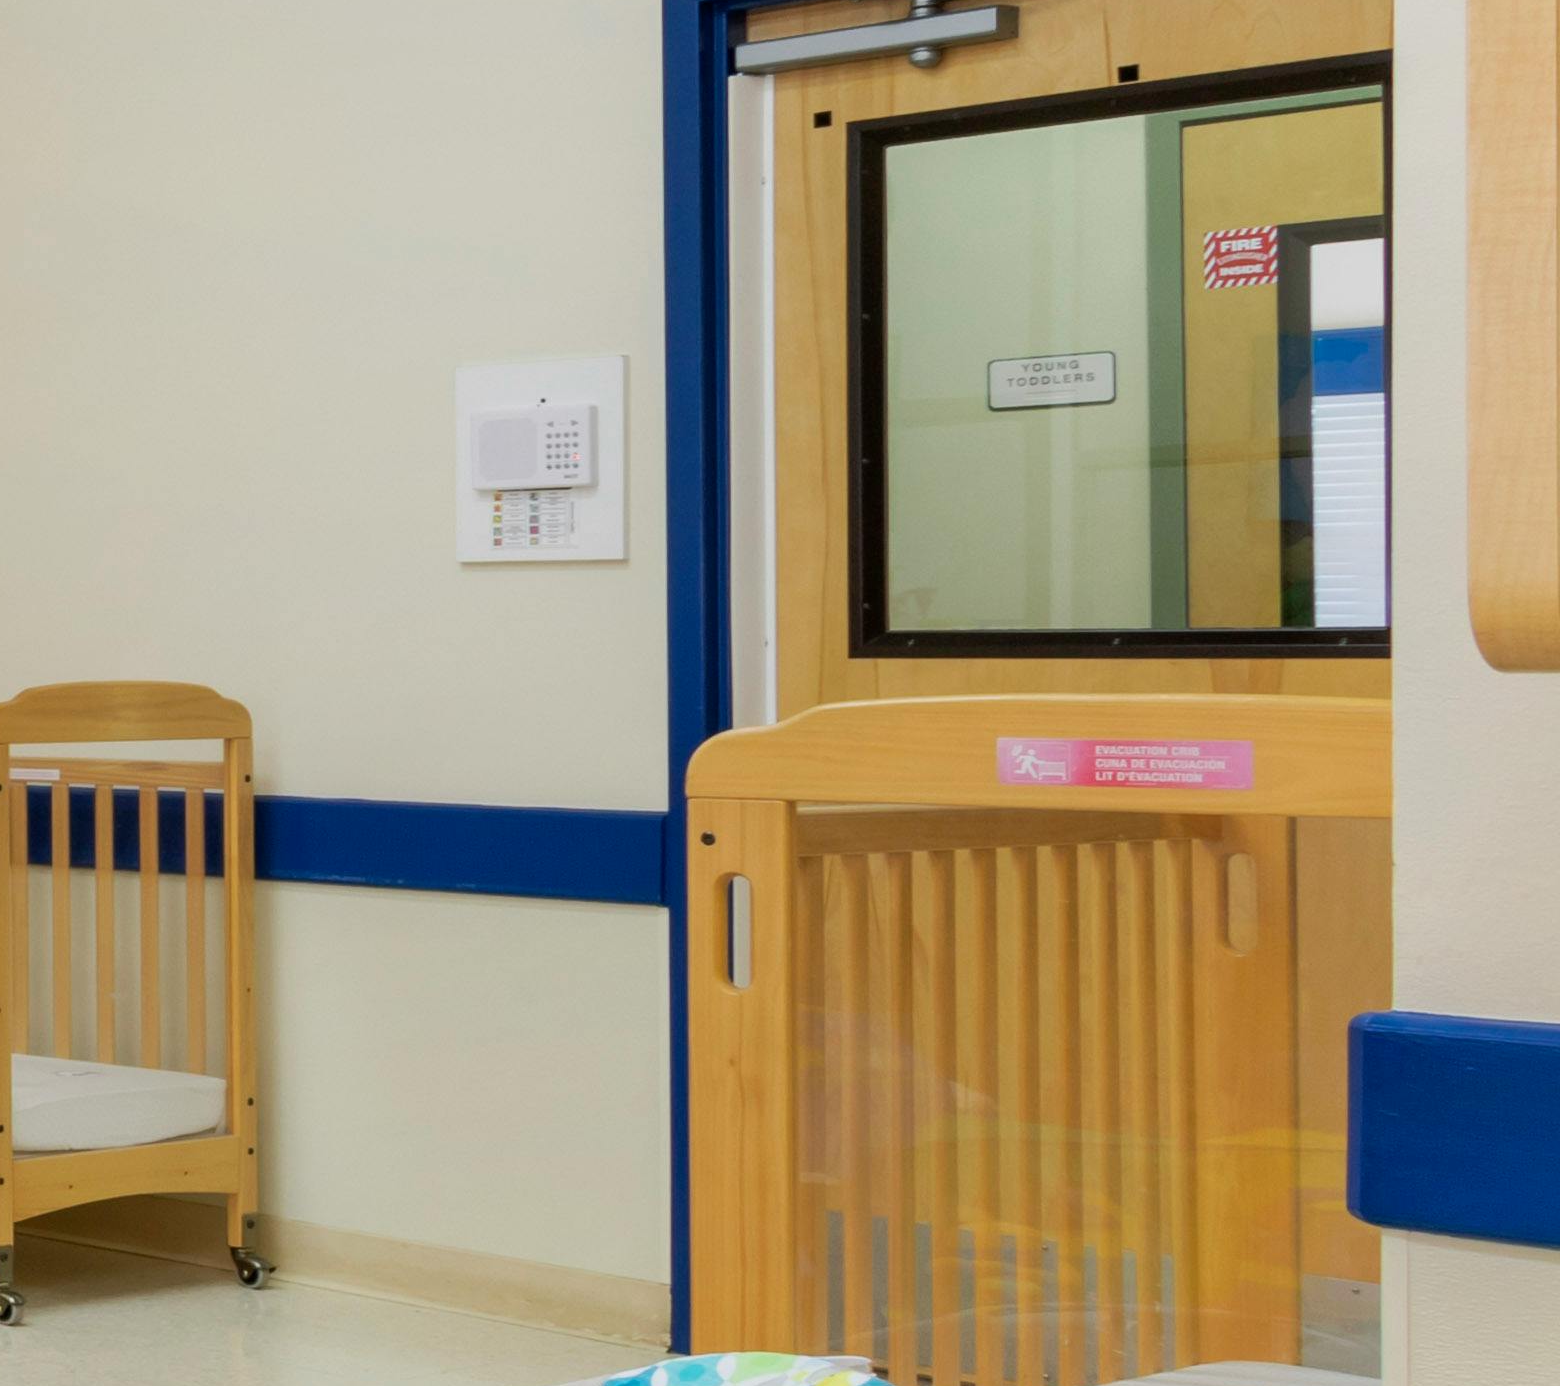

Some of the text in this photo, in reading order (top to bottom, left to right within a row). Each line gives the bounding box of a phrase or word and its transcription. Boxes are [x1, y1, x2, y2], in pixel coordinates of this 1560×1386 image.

[1220, 237, 1263, 253] FIRE
[1219, 263, 1265, 277] INSIDE
[1021, 359, 1080, 373] YOUNG
[1006, 372, 1096, 388] TODDLERS
[1095, 745, 1200, 756] EVACUATION CRIB
[1095, 758, 1128, 768] CUNA
[1130, 759, 1146, 769] DE
[1095, 771, 1113, 781] LIT
